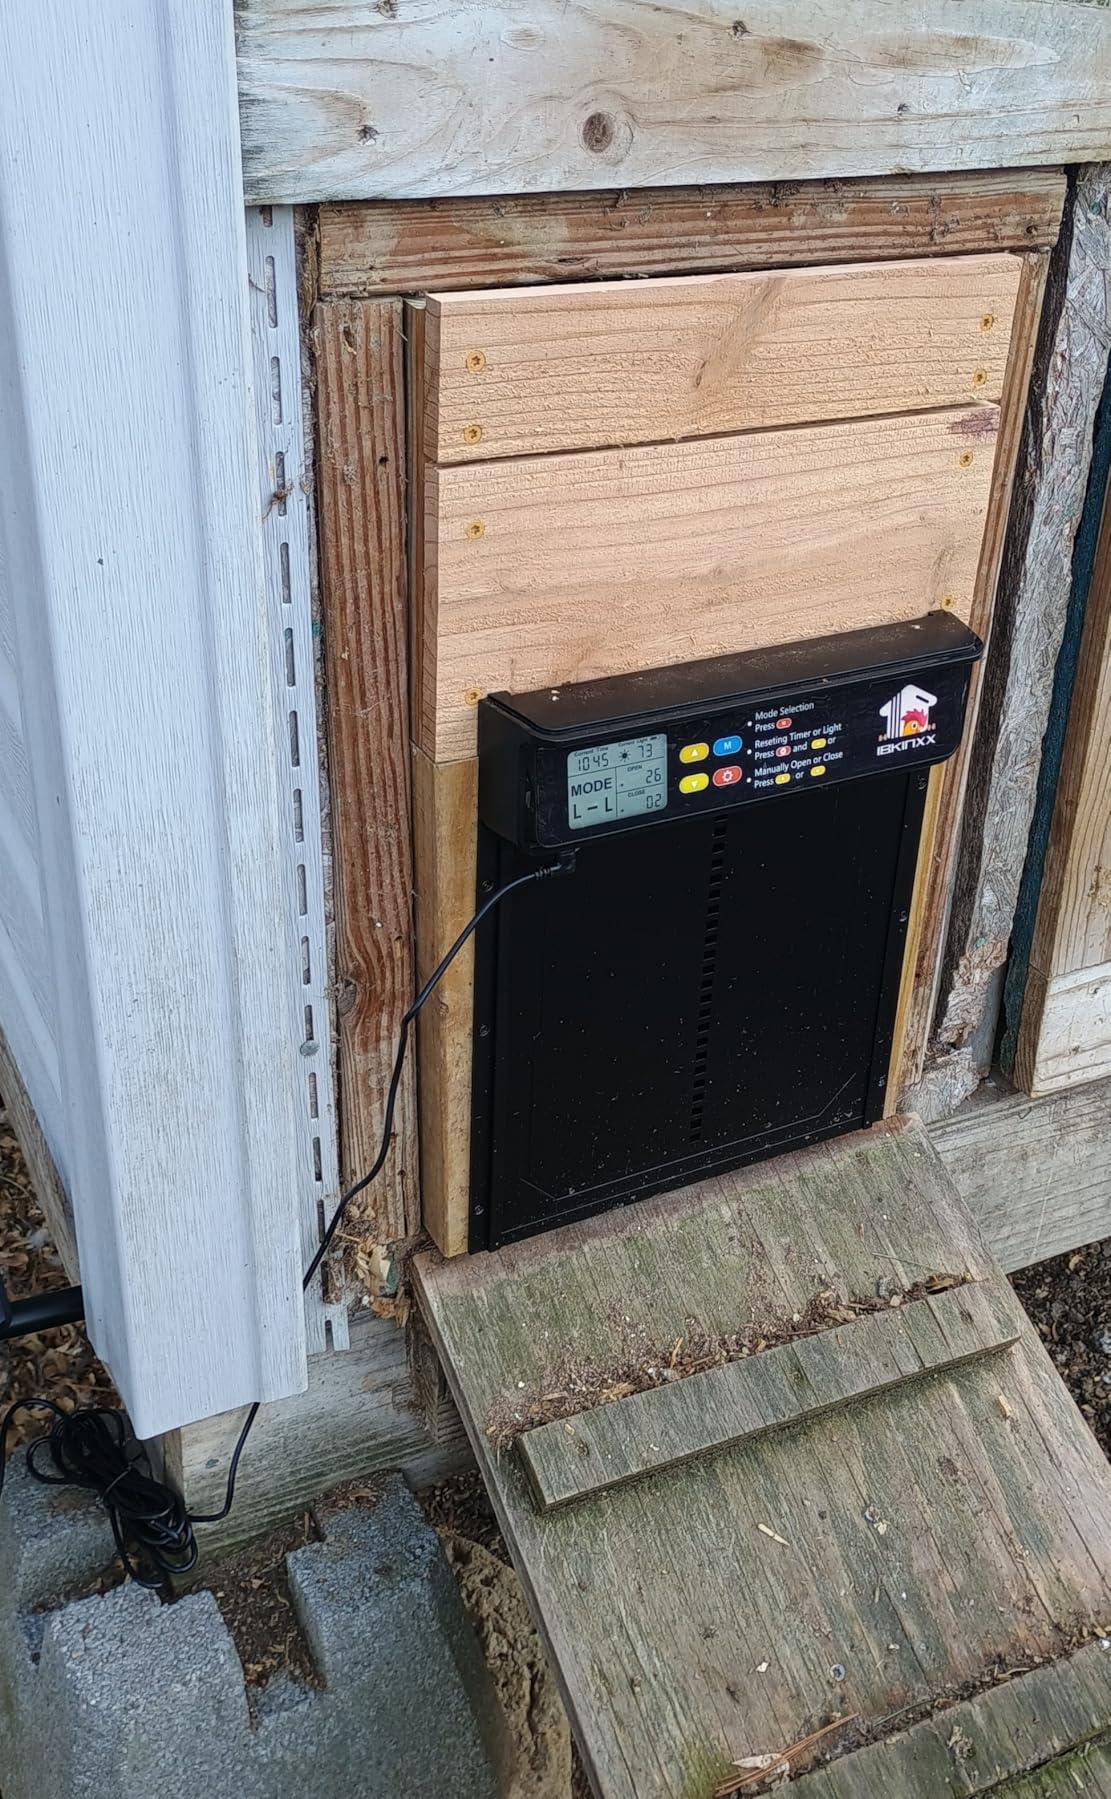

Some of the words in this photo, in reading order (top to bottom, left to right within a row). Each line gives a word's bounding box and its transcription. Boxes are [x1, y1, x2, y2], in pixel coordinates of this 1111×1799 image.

[755, 709, 778, 720] Mode
[780, 702, 814, 715] Selection
[755, 723, 775, 732] Press
[755, 736, 787, 749] Reseting
[789, 730, 811, 741] Timer
[823, 723, 842, 735] Light
[638, 743, 653, 758] 73
[723, 742, 732, 750] M
[754, 750, 775, 760] Press
[793, 741, 807, 752] and
[827, 736, 836, 744] or
[754, 762, 789, 777] Manually
[790, 759, 811, 769] Open
[813, 756, 822, 764] or
[823, 752, 843, 761] Close
[646, 768, 661, 784] 26
[754, 778, 774, 788] Press
[795, 771, 804, 779] or
[571, 777, 613, 797] MODE
[646, 794, 662, 809] 02
